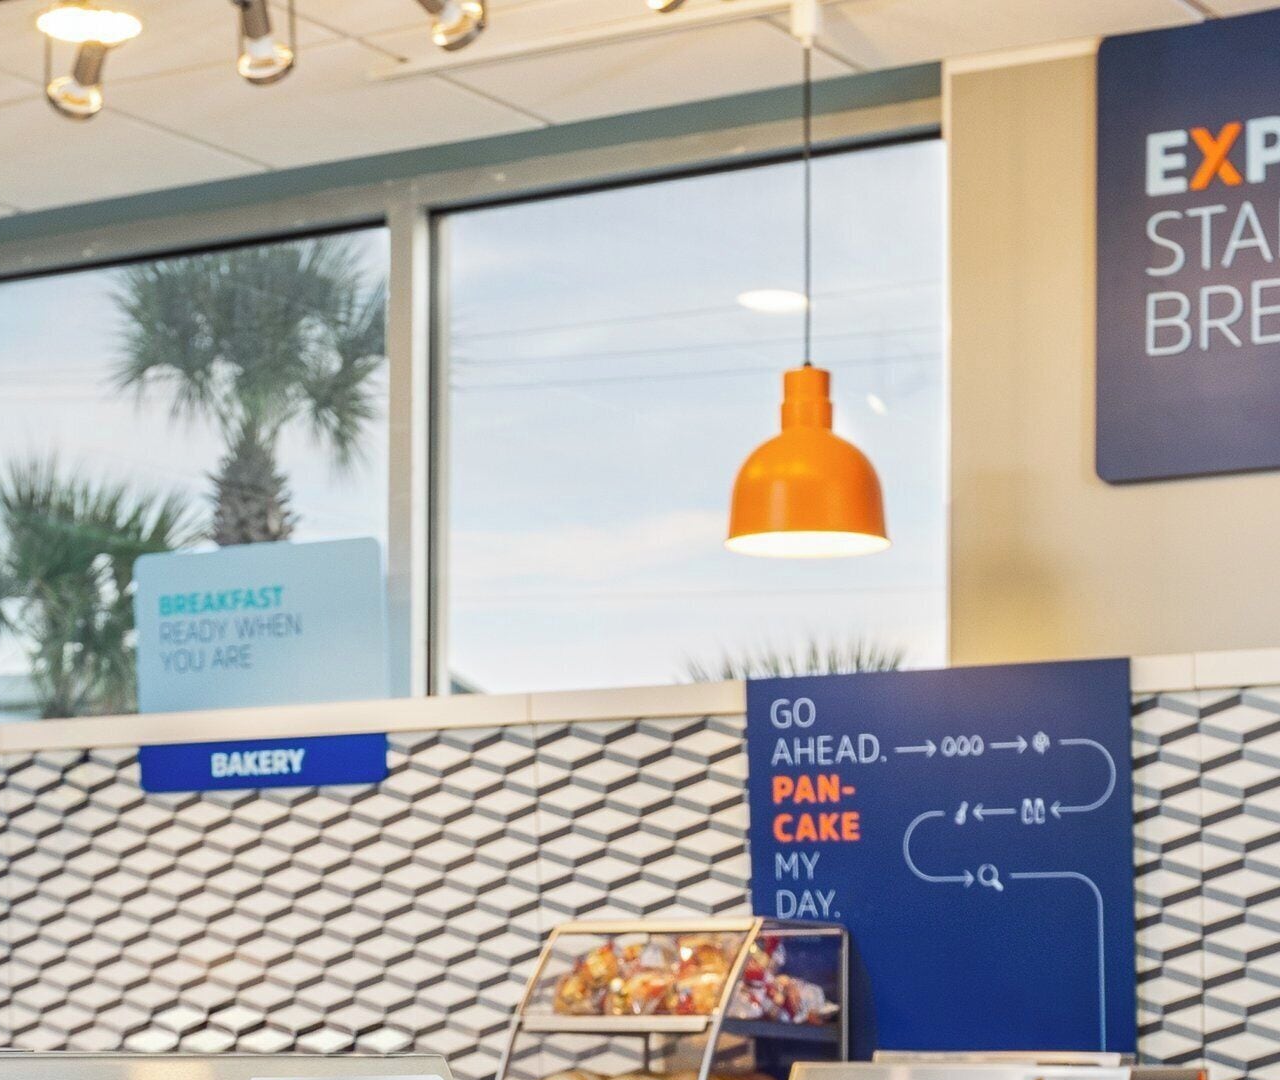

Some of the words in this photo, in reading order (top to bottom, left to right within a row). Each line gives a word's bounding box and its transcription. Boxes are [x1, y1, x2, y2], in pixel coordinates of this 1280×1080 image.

[159, 586, 283, 615] BREAKFAST
[159, 619, 227, 644] READY
[235, 612, 302, 639] WHEN
[160, 648, 205, 673] YOU
[211, 644, 252, 670] ARE
[770, 696, 816, 729] GO
[210, 748, 305, 777] BAKERY
[771, 733, 887, 766] AHEAD.
[772, 773, 856, 805] PAN-
[773, 810, 862, 842] CAKE
[775, 851, 820, 880] MY
[776, 888, 840, 919] DAY.
